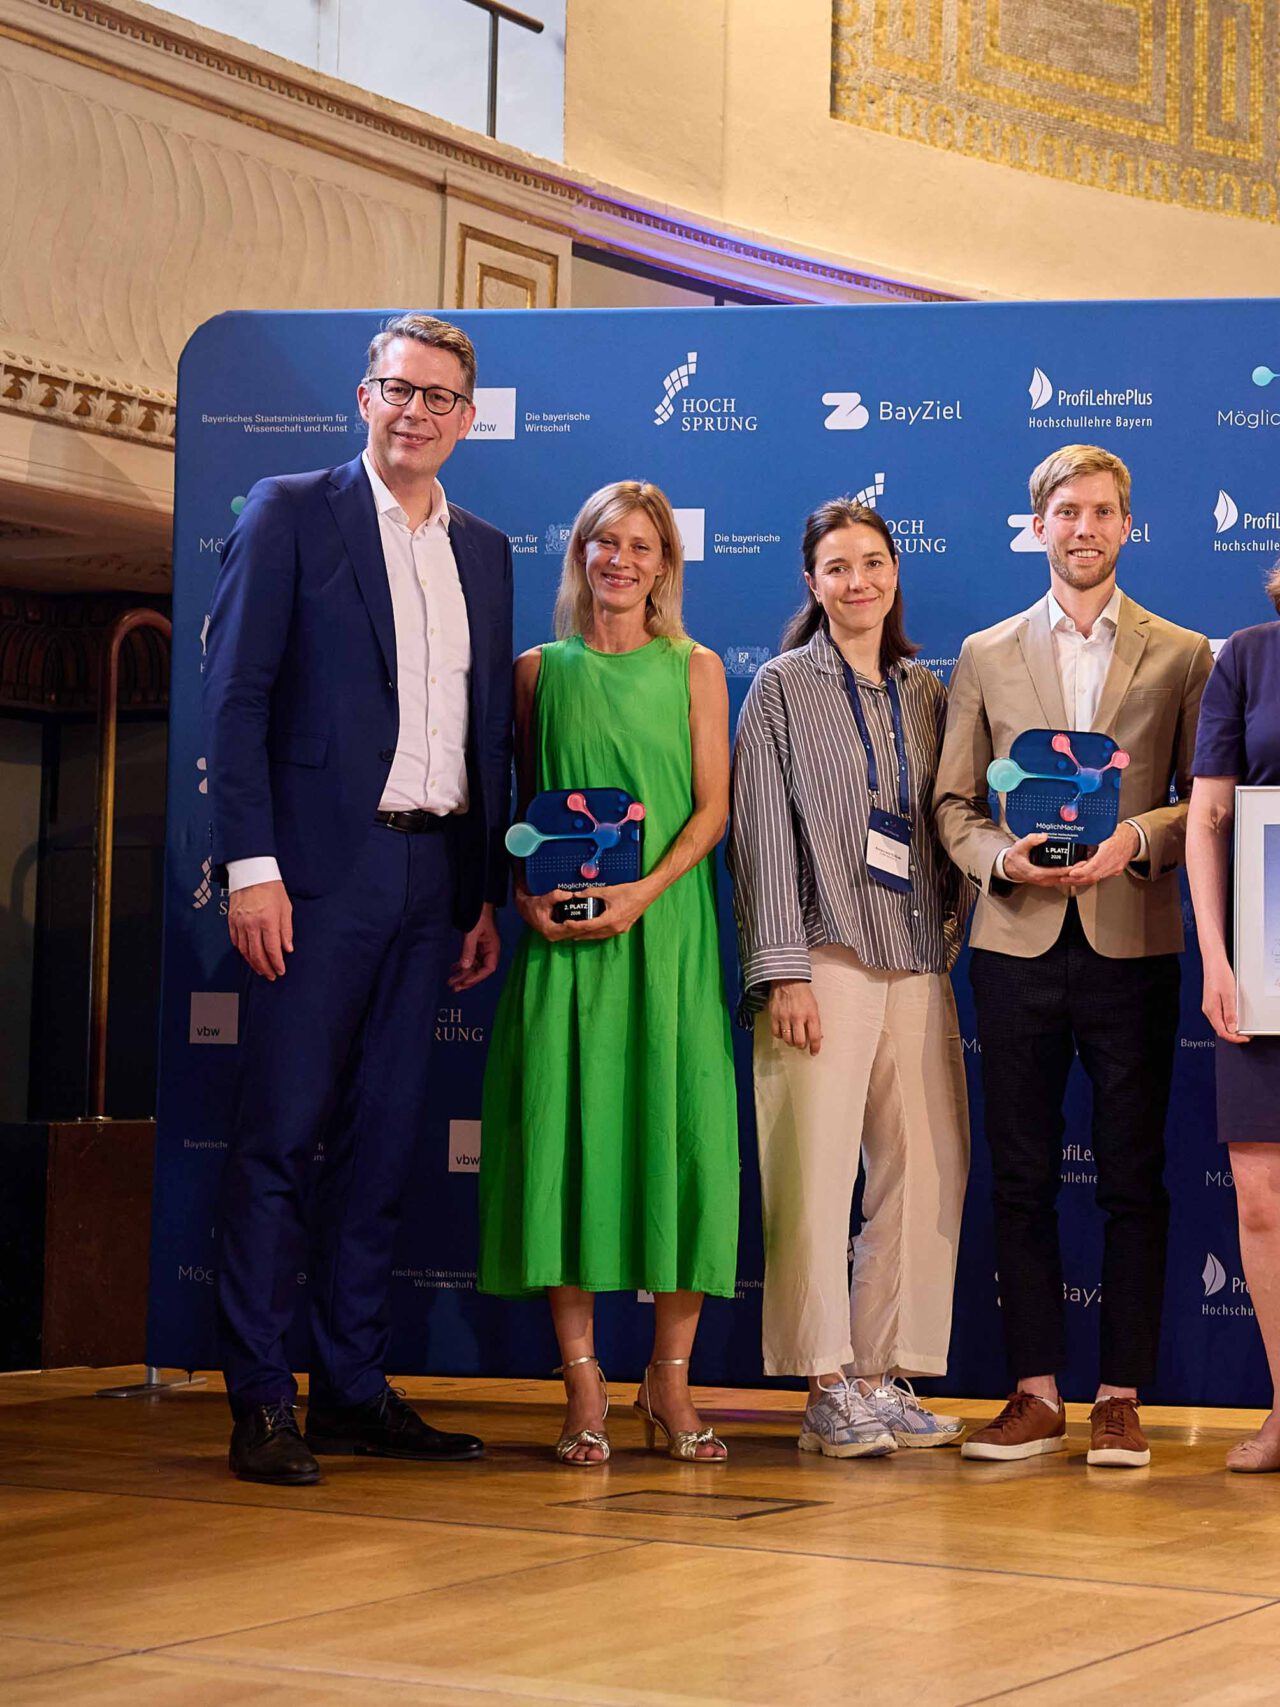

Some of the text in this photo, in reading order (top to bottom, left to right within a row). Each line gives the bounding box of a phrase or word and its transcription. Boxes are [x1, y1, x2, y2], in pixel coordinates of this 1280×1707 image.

[1058, 390, 1153, 407] ProfiLehrePlus
[681, 398, 736, 413] HOCH
[525, 412, 591, 422] Die bayerische
[879, 400, 963, 426] BayZiel
[202, 414, 348, 424] Bayerisches Staatsministerium für
[681, 416, 758, 432] SPRUNG
[1028, 416, 1153, 430] Hochschullehre Bayern
[244, 424, 348, 433] Wissenschaft und Kunst
[472, 421, 497, 432] vbw
[524, 424, 571, 432] Wirtschaft
[884, 520, 924, 534] OCH
[526, 534, 538, 544] für
[714, 533, 781, 545] Die bayerische
[512, 544, 538, 554] Kunst
[714, 544, 760, 554] Wirtschaft
[892, 538, 947, 553] RUNG
[914, 657, 958, 668] bayerisch
[1036, 822, 1085, 832] MöglichMacher
[558, 881, 606, 890] MöglichMacher
[196, 1026, 220, 1036] vbw
[1180, 1038, 1215, 1049] Bayeris
[456, 1154, 480, 1166] vbw
[1202, 1304, 1254, 1316] Hochschu
